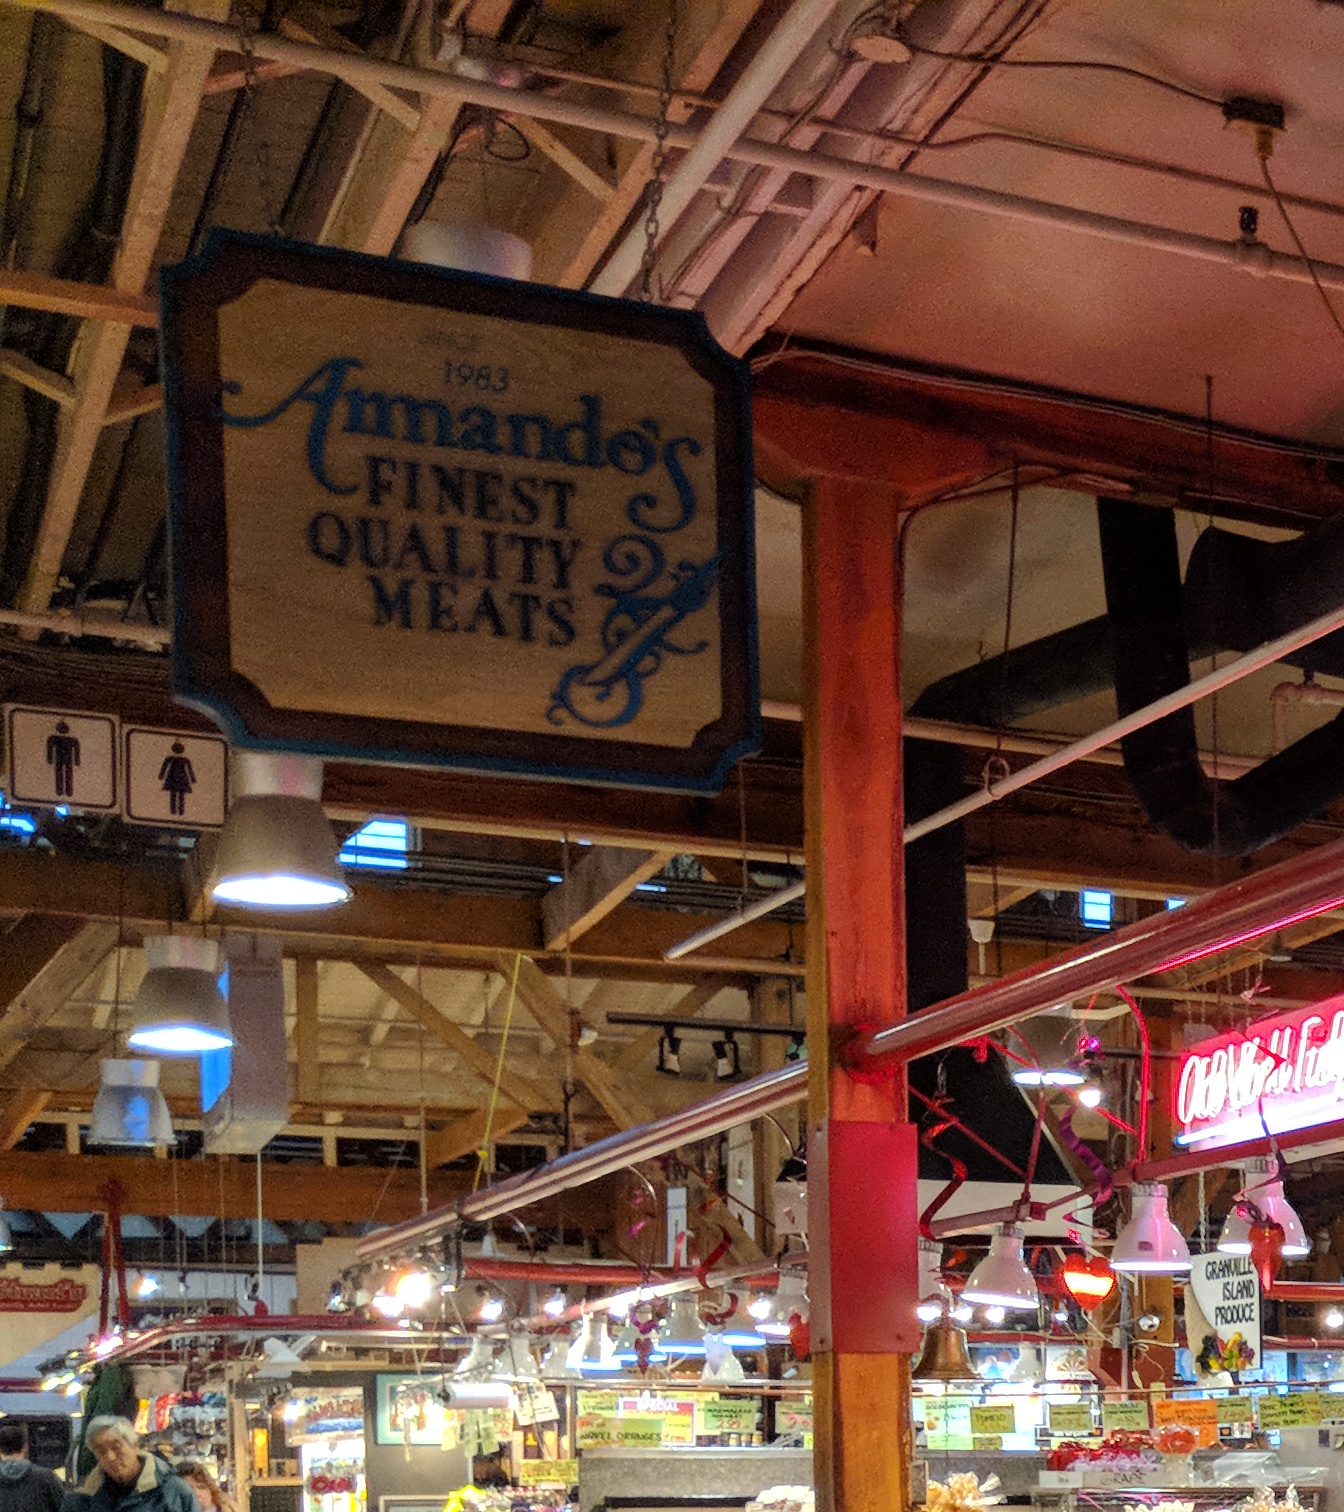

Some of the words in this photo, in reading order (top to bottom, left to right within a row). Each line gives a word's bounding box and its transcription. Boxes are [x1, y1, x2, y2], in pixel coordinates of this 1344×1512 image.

[444, 359, 510, 393] 1983
[366, 454, 577, 530] FINEST
[307, 511, 584, 589] QUALITY
[366, 574, 577, 646] MEATS
[1205, 1256, 1253, 1280] GRANVILLE
[1223, 1279, 1255, 1302] ISLAND
[1215, 1303, 1254, 1326] PRODUCE
